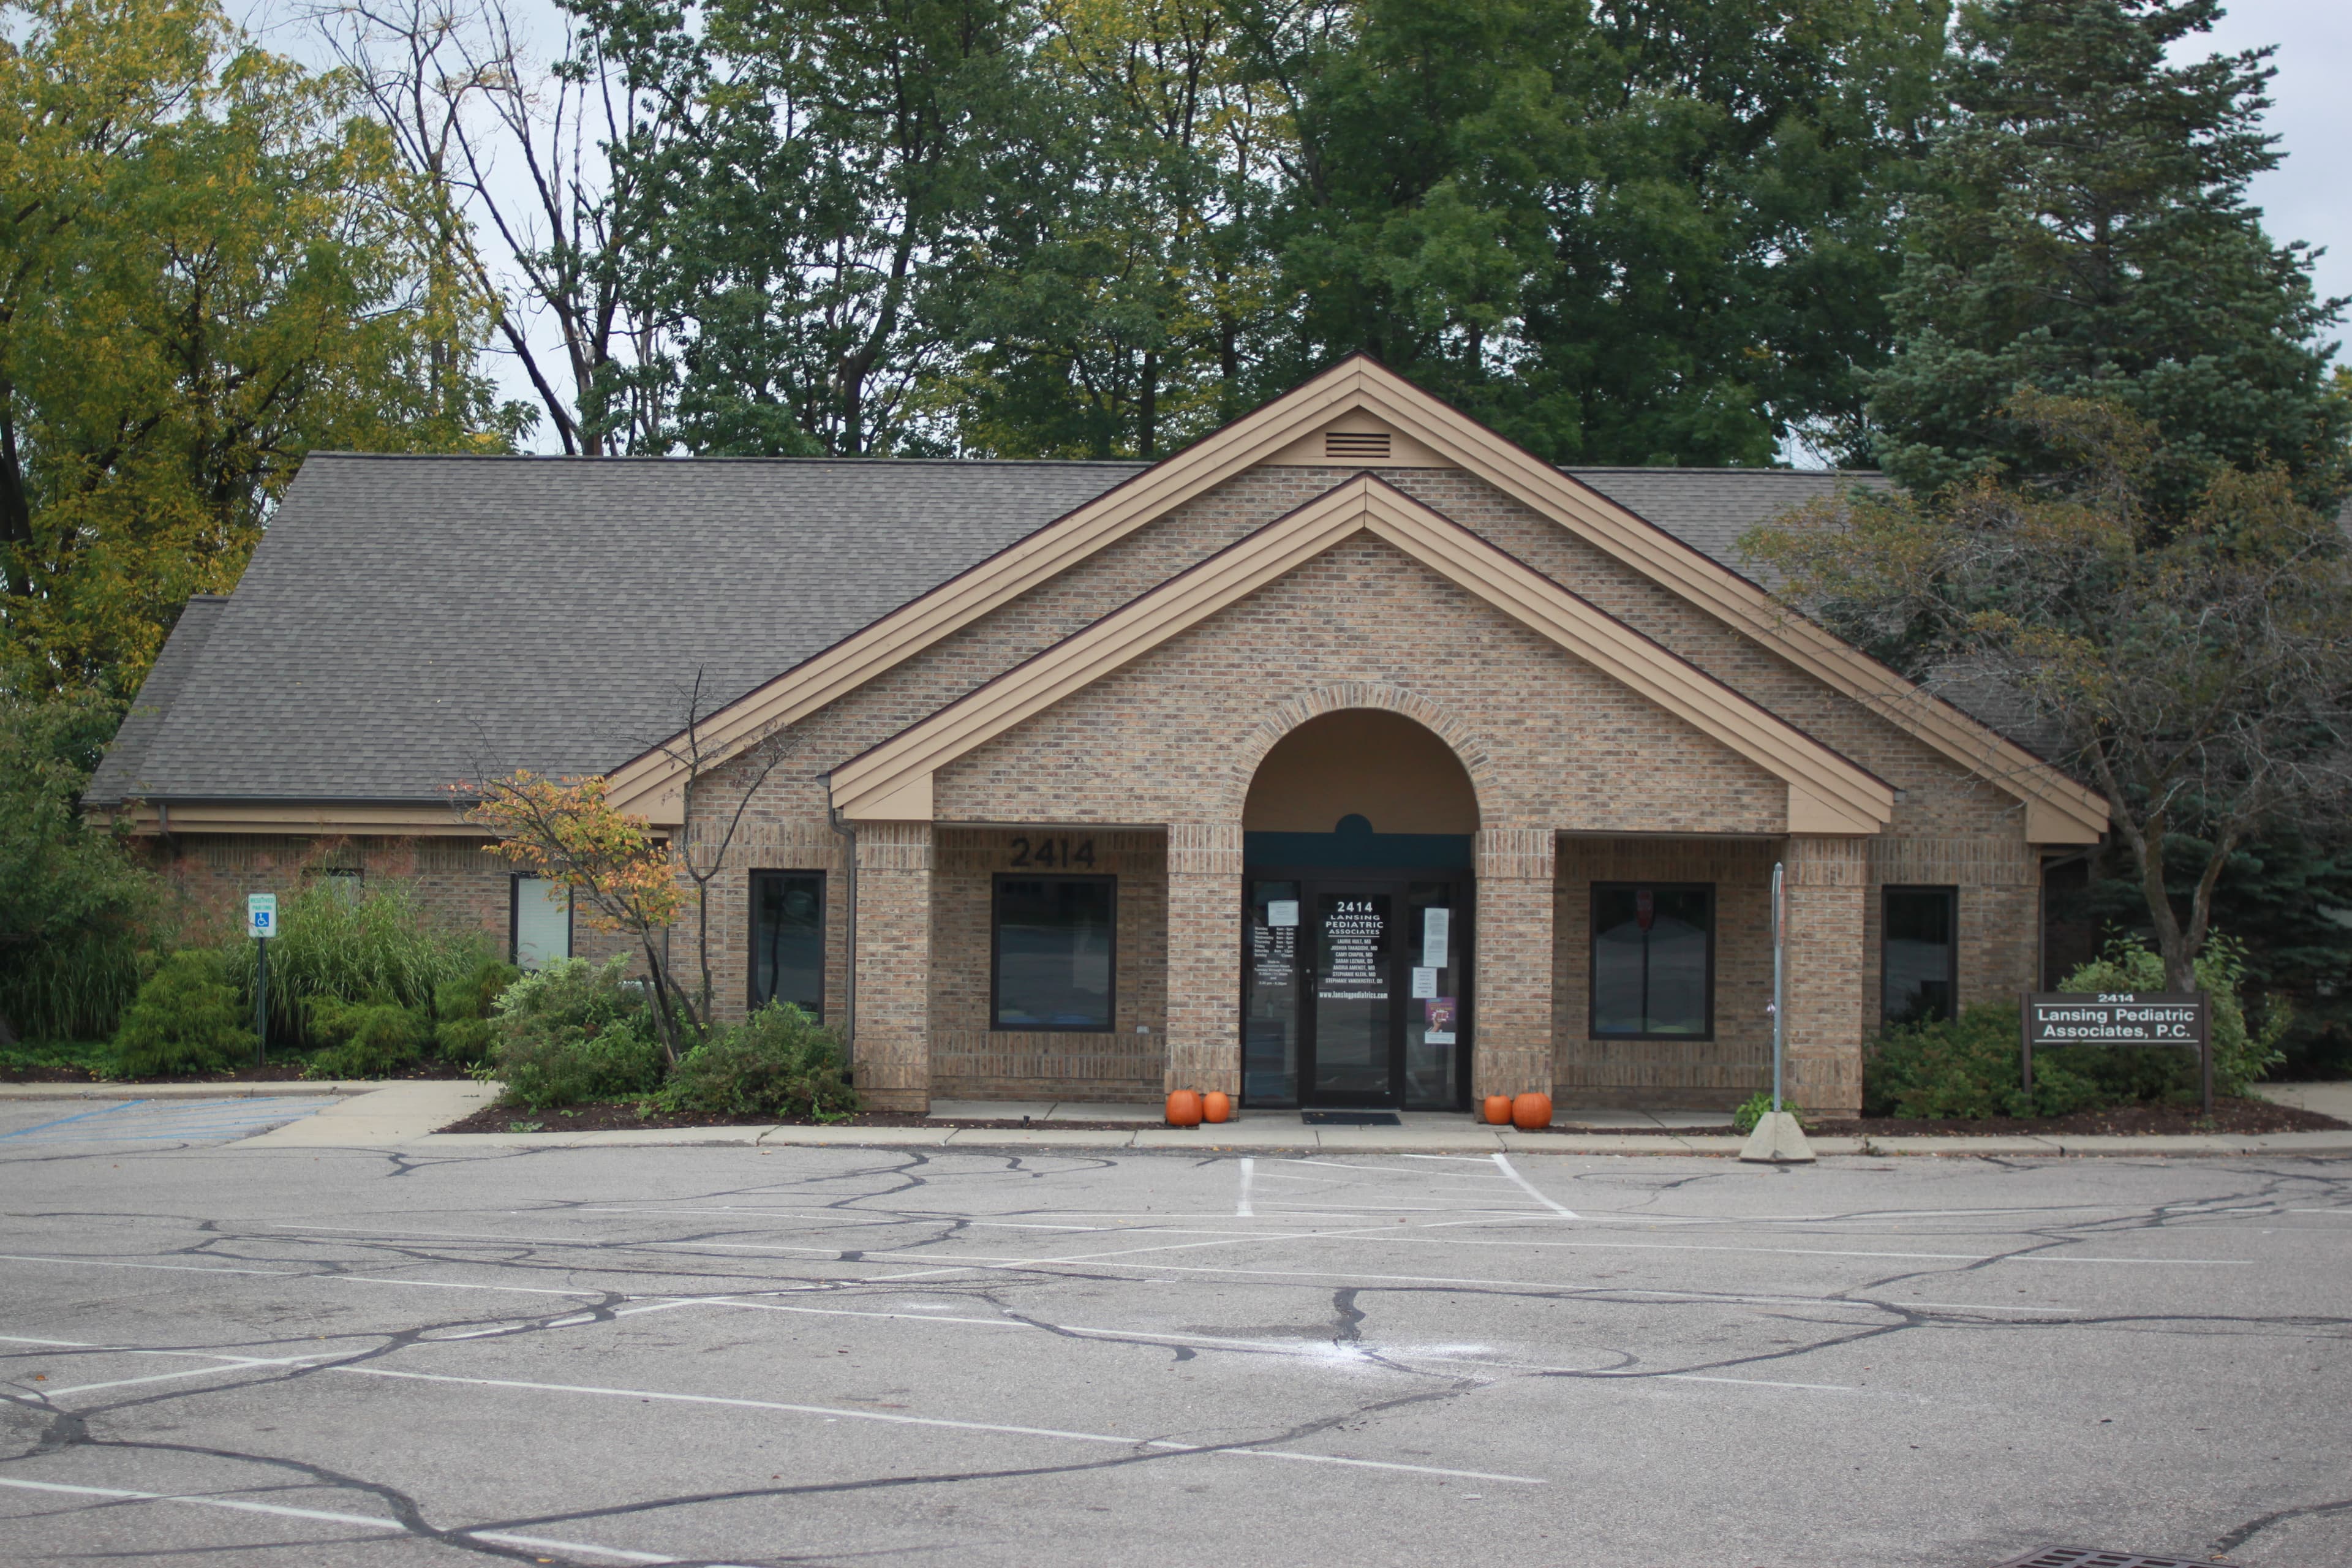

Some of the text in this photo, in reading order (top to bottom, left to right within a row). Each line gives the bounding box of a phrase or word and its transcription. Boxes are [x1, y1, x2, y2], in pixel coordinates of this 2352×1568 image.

[1011, 837, 1096, 868] 2414
[1337, 901, 1373, 912] 2414
[1319, 990, 1388, 1000] www.lansingpediatrics.com
[2098, 993, 2135, 1003] 2414
[2038, 1008, 2195, 1023] Lansing Pediatric
[2043, 1024, 2191, 1039] Associates, P.C.
